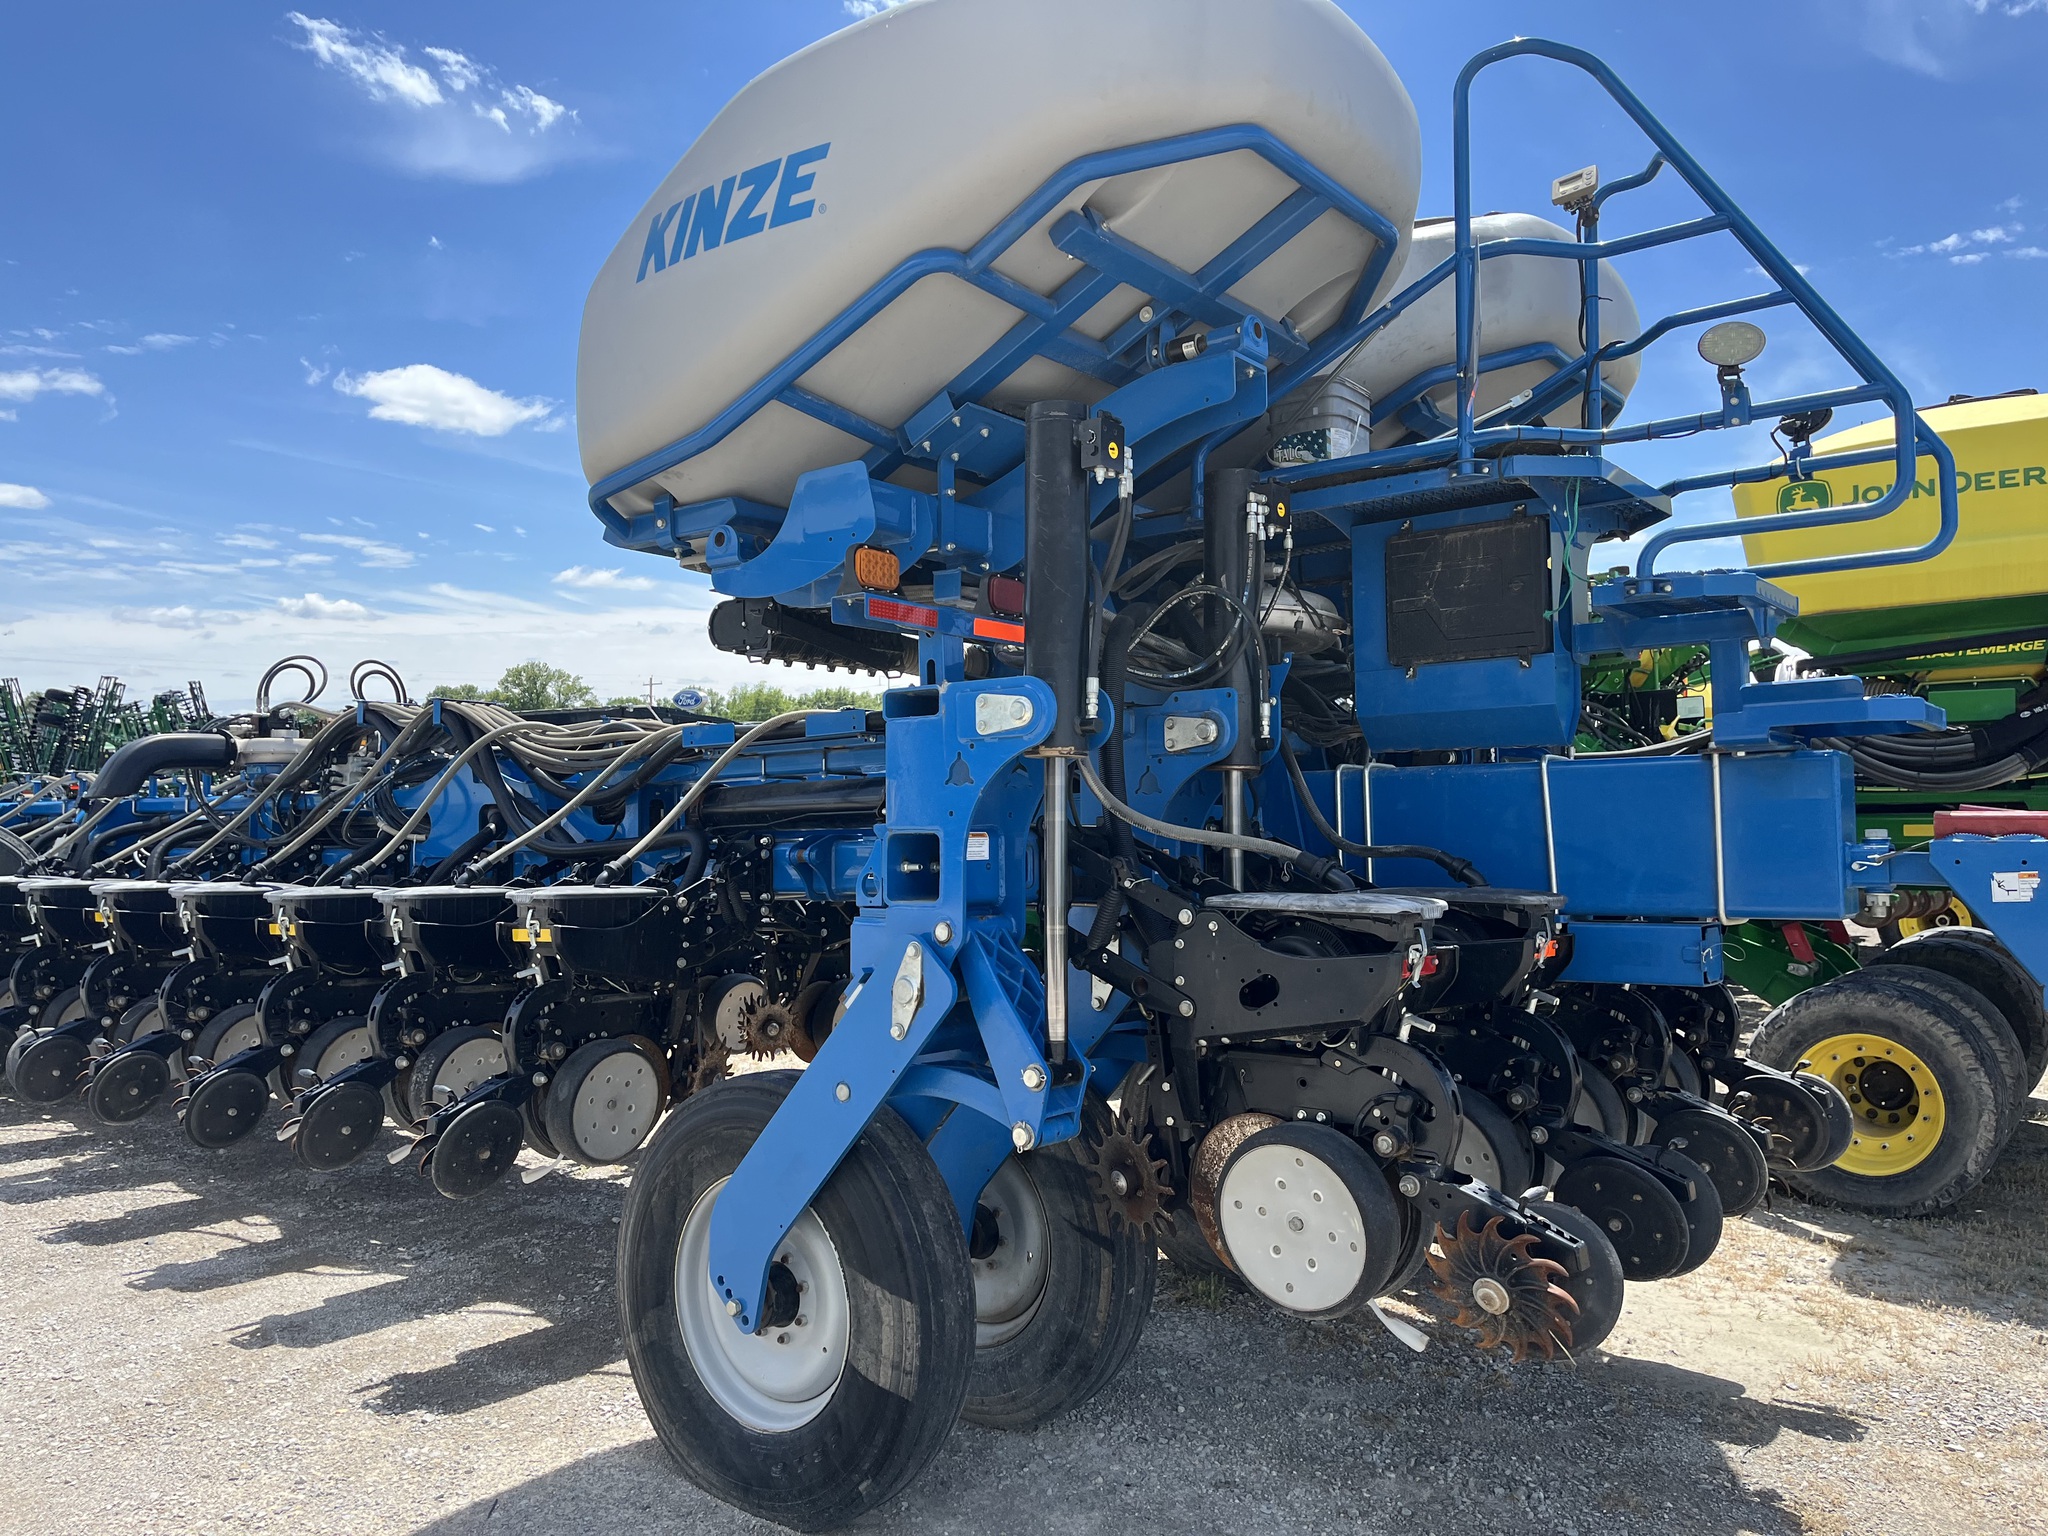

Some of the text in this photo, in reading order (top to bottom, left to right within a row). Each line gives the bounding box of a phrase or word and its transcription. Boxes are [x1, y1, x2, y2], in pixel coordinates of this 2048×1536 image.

[636, 142, 831, 284] KINZE
[1905, 639, 2046, 660] EMERGE
[678, 693, 696, 705] Ford
